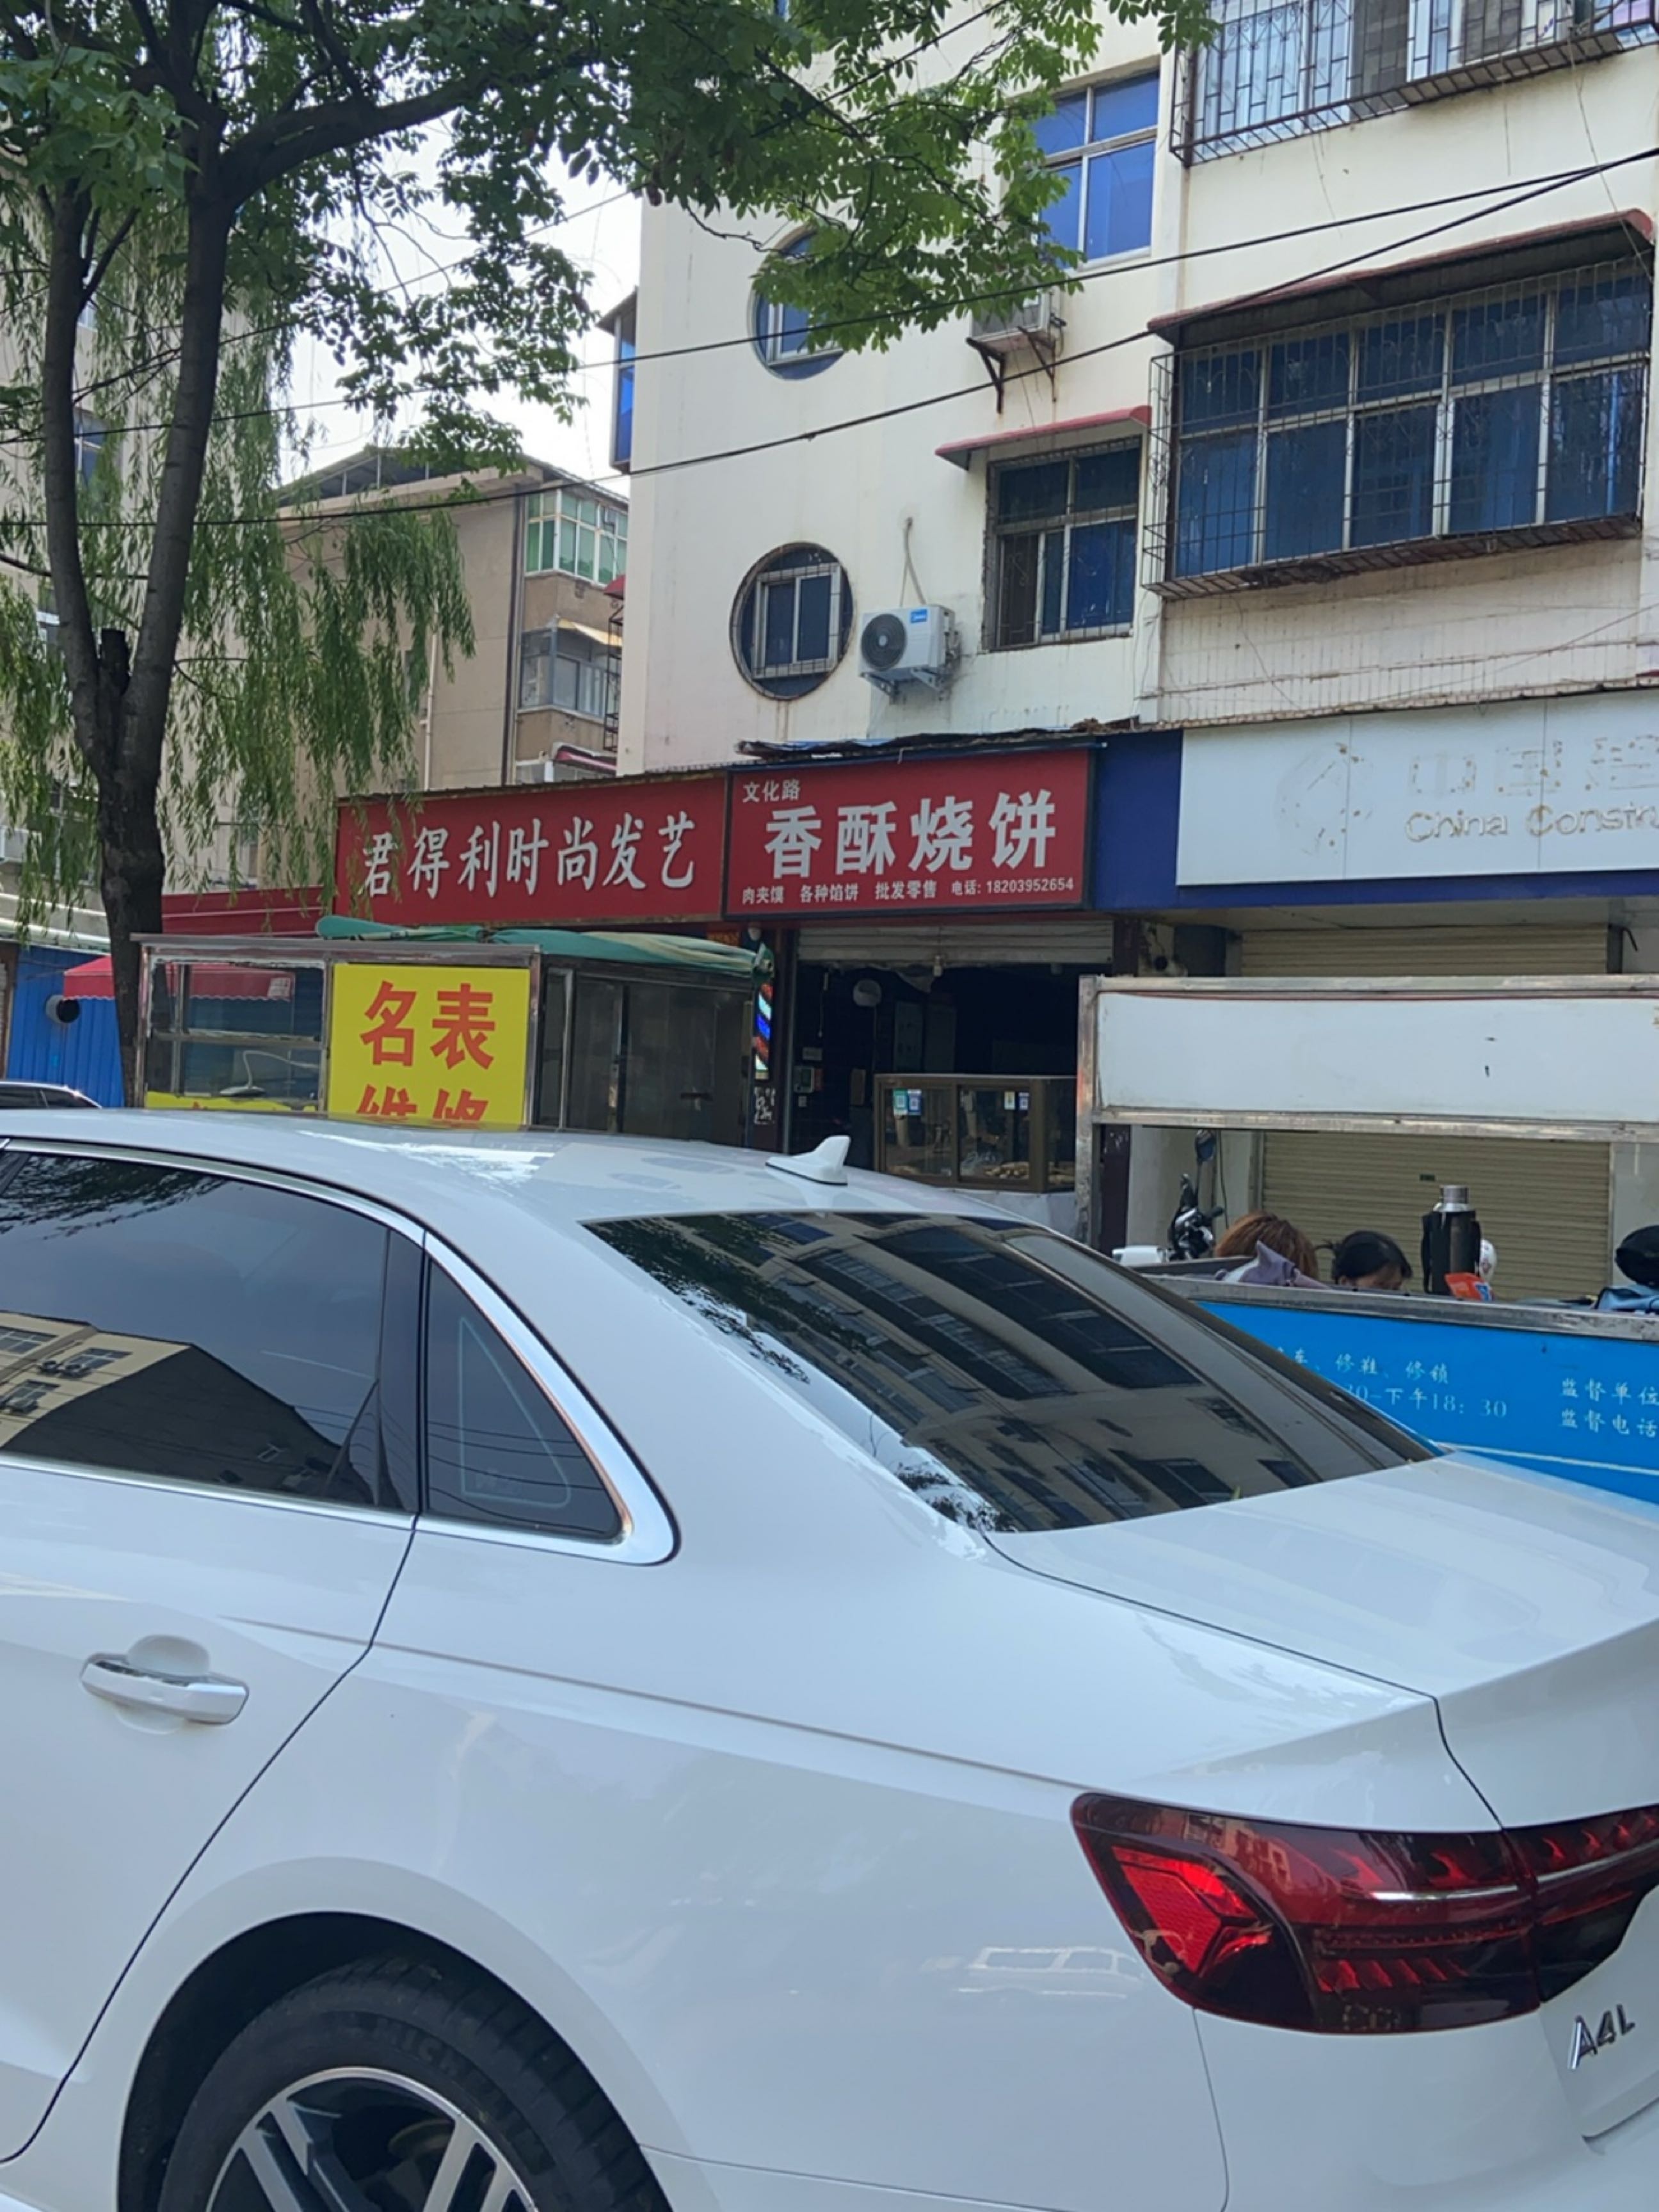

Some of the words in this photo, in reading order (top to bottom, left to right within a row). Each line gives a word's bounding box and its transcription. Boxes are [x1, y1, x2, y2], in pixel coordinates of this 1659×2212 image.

[742, 779, 800, 803] 文化路
[764, 789, 1056, 879] 香酥烧饼
[1406, 808, 1508, 843] China
[361, 810, 696, 899] 君得利时尚发艺
[742, 885, 784, 904] 肉夹馍
[800, 883, 859, 903] 各种馅饼
[875, 879, 937, 900] 批发零售
[360, 980, 496, 1070] 名表
[1559, 1409, 1658, 1438] 监督电话
[1568, 2004, 1635, 2071] A4L
